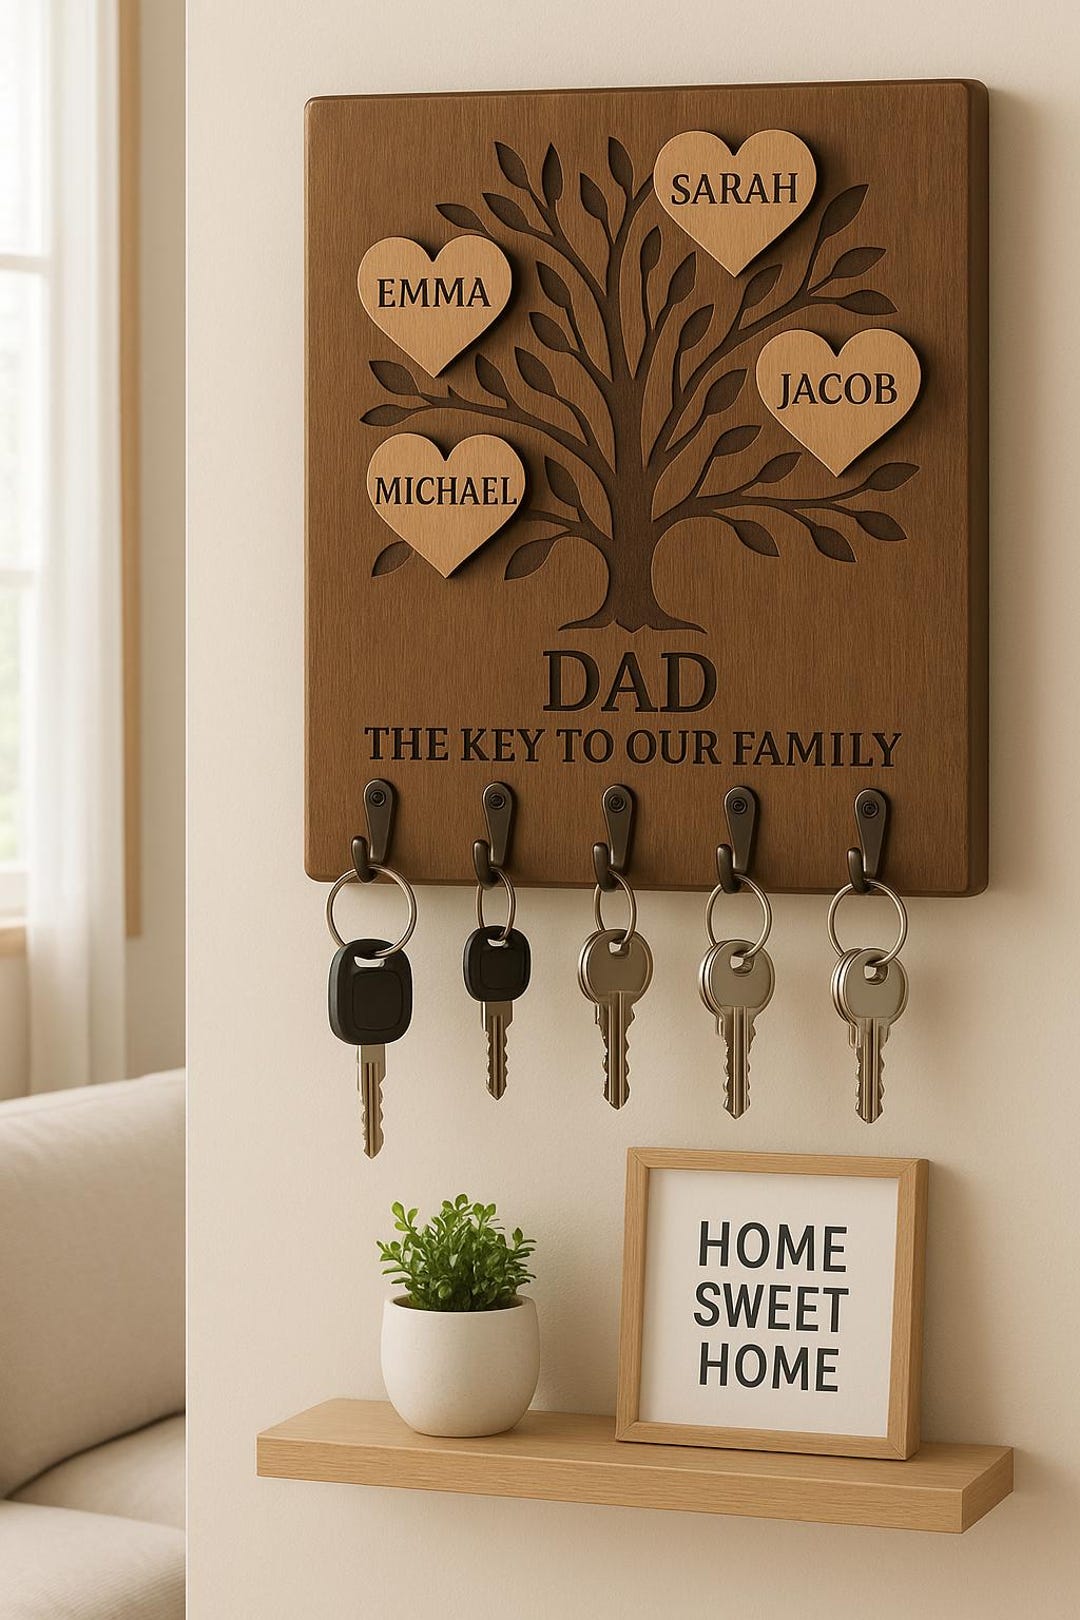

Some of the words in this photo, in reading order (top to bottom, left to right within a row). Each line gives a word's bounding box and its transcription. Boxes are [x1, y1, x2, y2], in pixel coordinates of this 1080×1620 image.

[671, 172, 798, 206] SARAH
[376, 277, 492, 309] EMMA
[777, 372, 898, 410] JACOB
[374, 475, 518, 507] MICHAEL
[542, 649, 718, 714] DAD
[364, 726, 449, 762] THE
[460, 727, 546, 764] KEY
[556, 728, 615, 766] TO
[626, 729, 722, 767] OUR
[733, 731, 903, 768] FAMILY
[699, 1220, 848, 1273] HOME
[693, 1281, 849, 1333] SWEET
[699, 1341, 840, 1393] HOME
